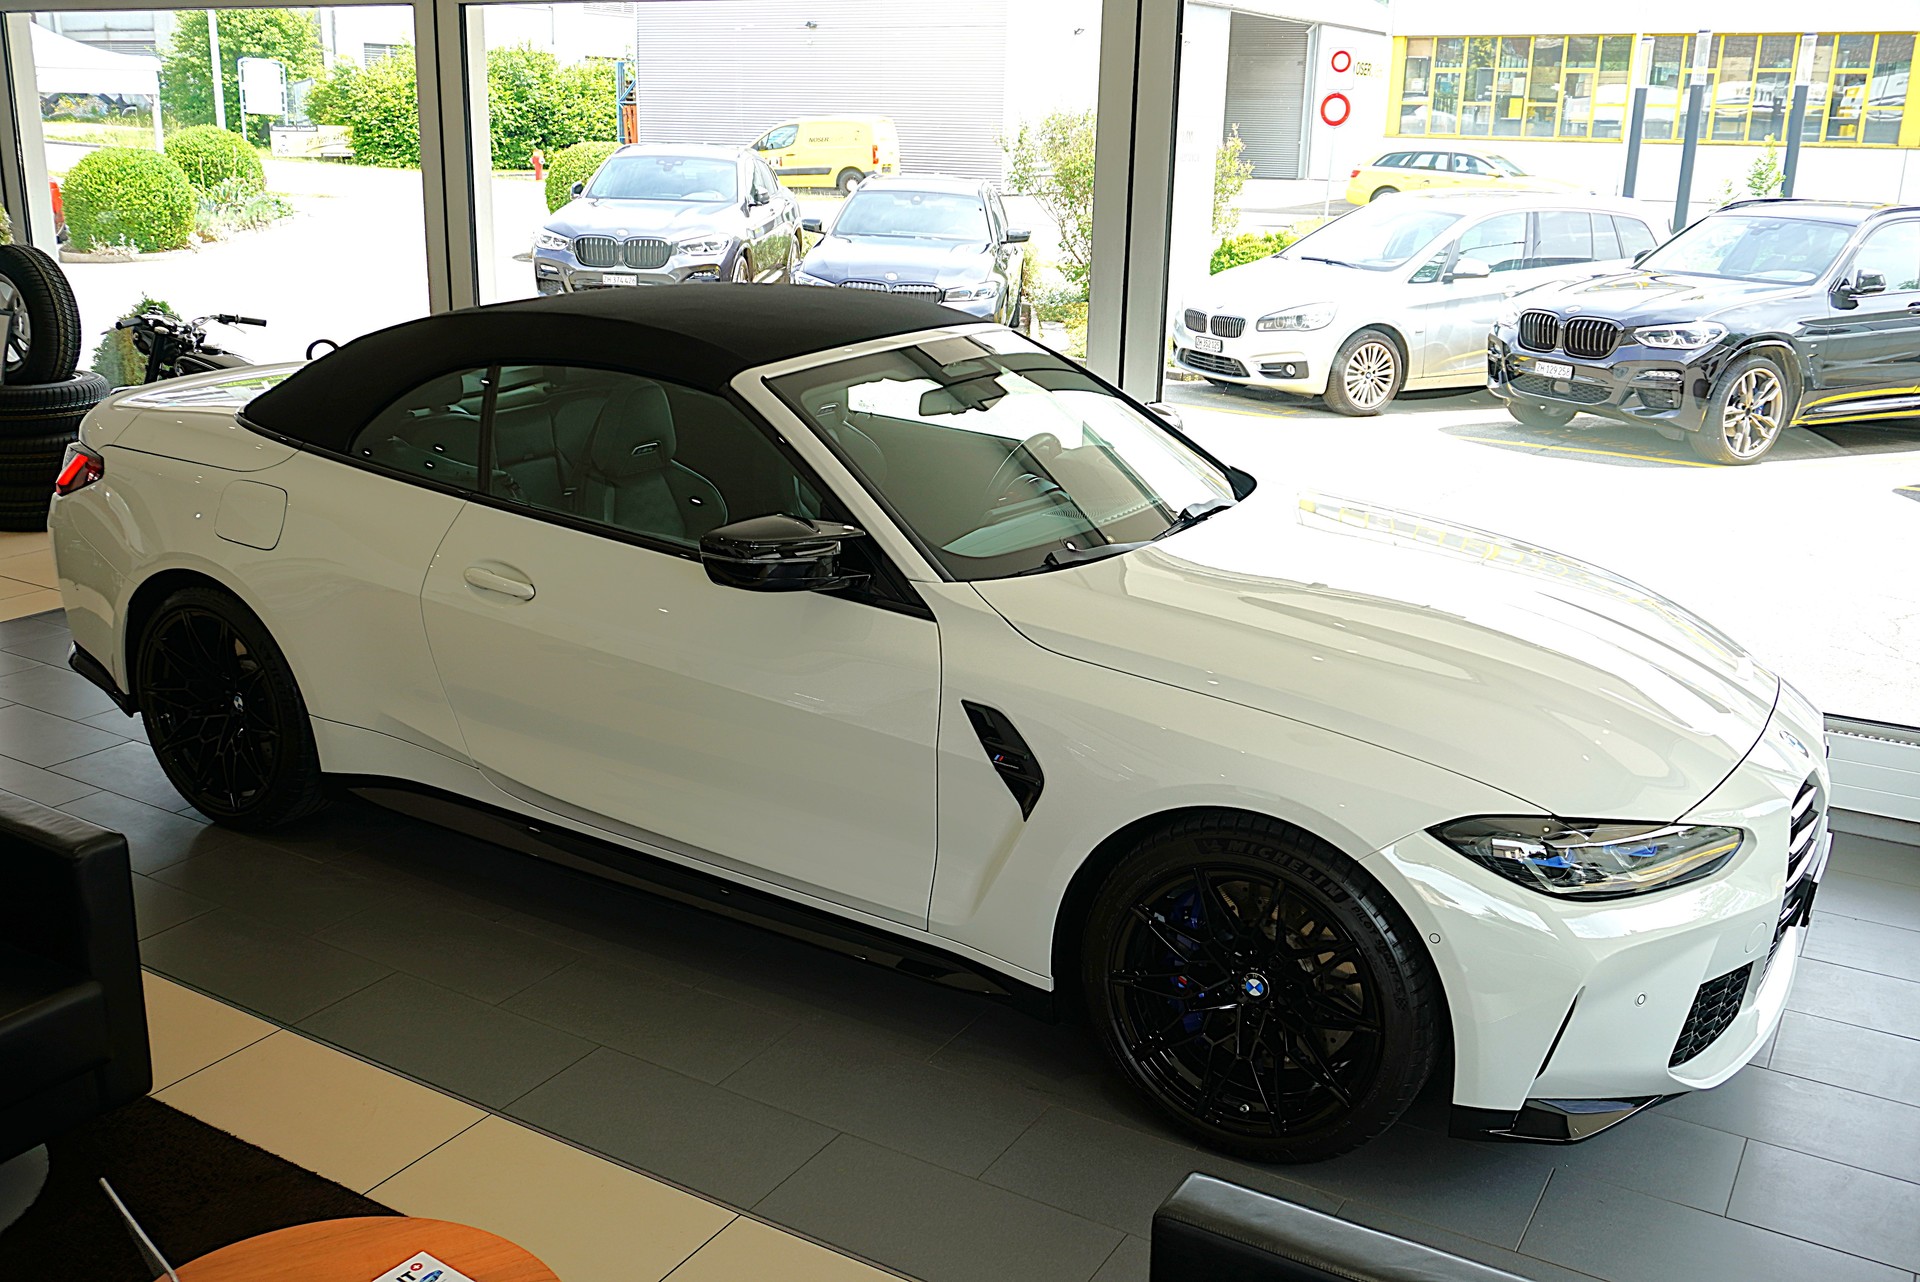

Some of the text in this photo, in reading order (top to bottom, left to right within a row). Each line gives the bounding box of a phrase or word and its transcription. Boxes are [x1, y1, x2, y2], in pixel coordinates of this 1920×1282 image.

[1354, 61, 1372, 76] OSER
[1226, 839, 1345, 900] MICHELIN
[1351, 906, 1378, 934] PILOT
